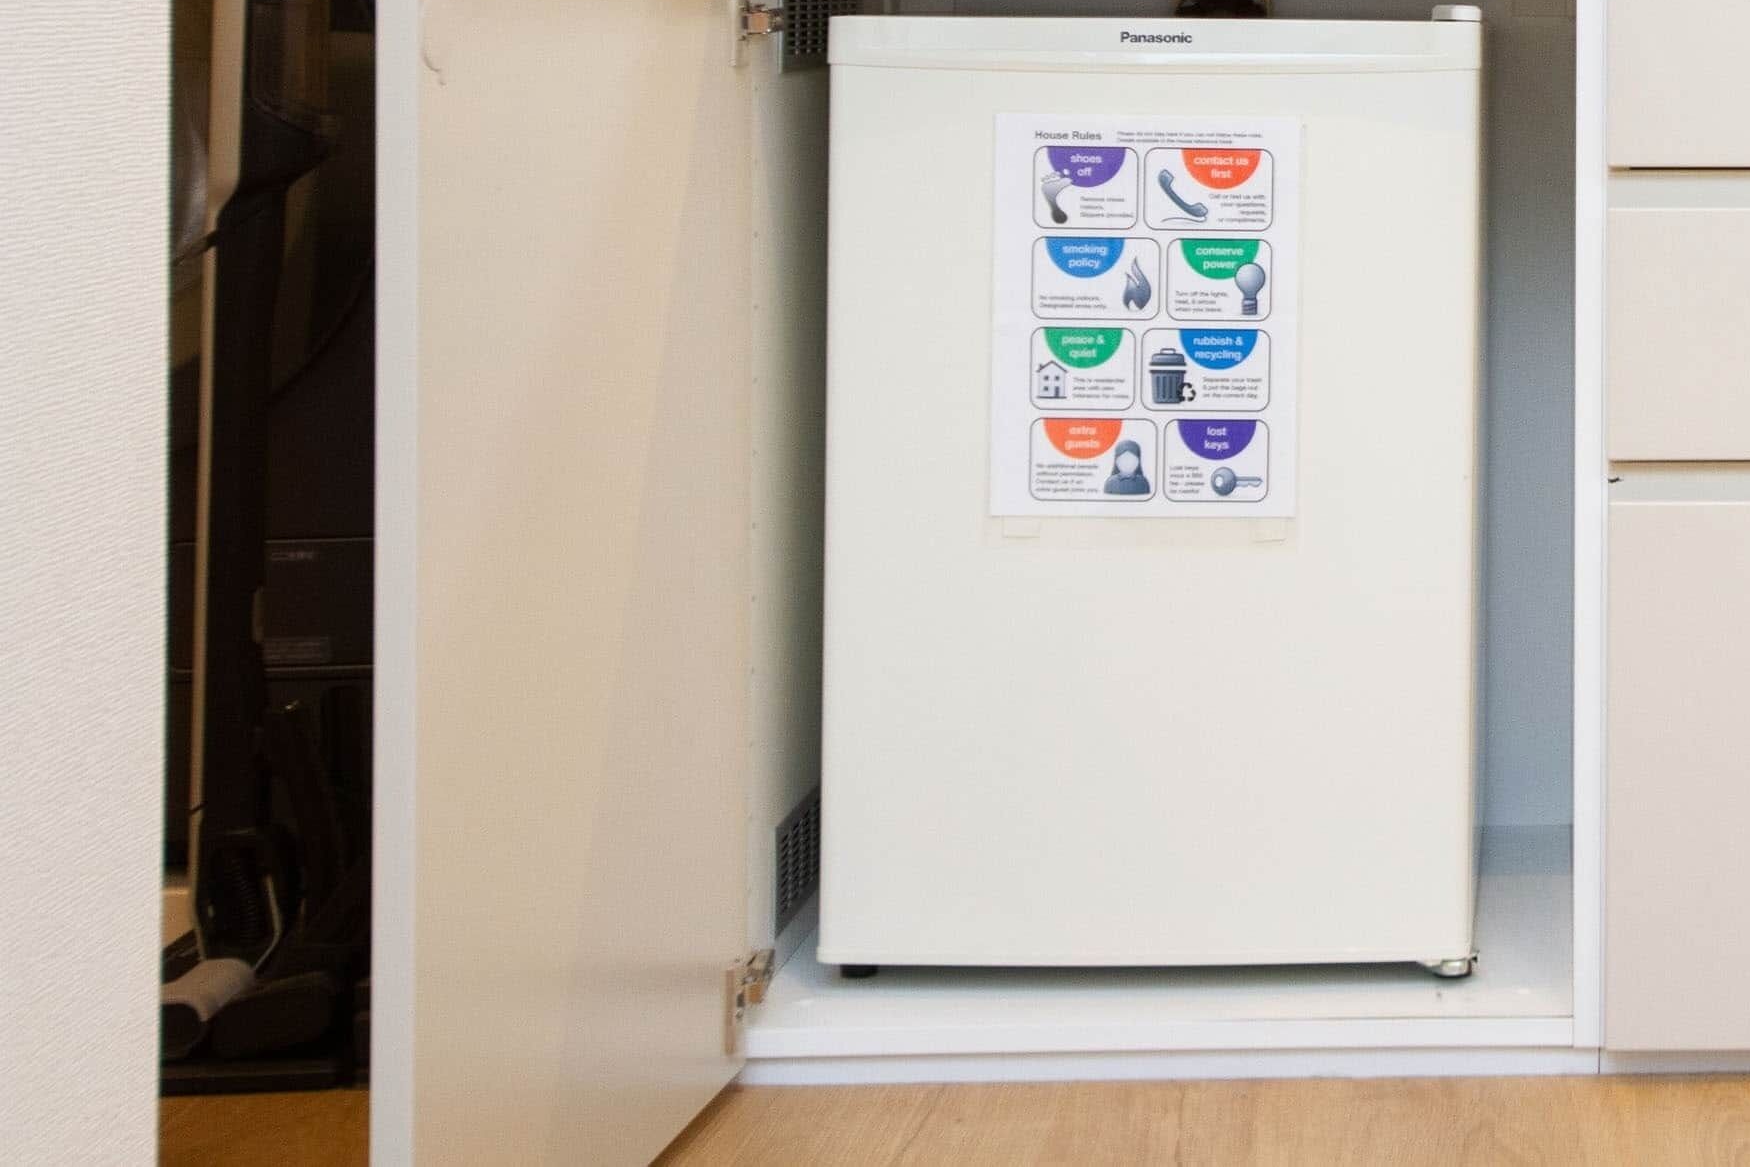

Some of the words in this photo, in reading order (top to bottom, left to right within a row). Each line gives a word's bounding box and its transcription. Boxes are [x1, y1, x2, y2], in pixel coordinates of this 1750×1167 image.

[1119, 31, 1192, 43] Panasonic
[1035, 130, 1069, 140] House
[1072, 131, 1102, 141] Rules
[1070, 154, 1102, 163] shoes
[1193, 157, 1233, 166] contact
[1236, 158, 1249, 166] us
[1077, 167, 1093, 176] off
[1211, 169, 1232, 179] first
[1062, 245, 1108, 256] smoking
[1196, 248, 1244, 256] conserve
[1068, 258, 1100, 269] policy
[1203, 261, 1238, 270] power
[1061, 336, 1095, 346] peace
[1096, 335, 1105, 345] &
[1193, 336, 1233, 346] rubbish
[1235, 336, 1244, 346] &
[1069, 348, 1097, 359] quiet
[1194, 349, 1242, 362] recycling
[1068, 426, 1097, 436] extra
[1207, 426, 1227, 436] lost
[1064, 439, 1100, 451] guests
[1204, 439, 1230, 451] keys
